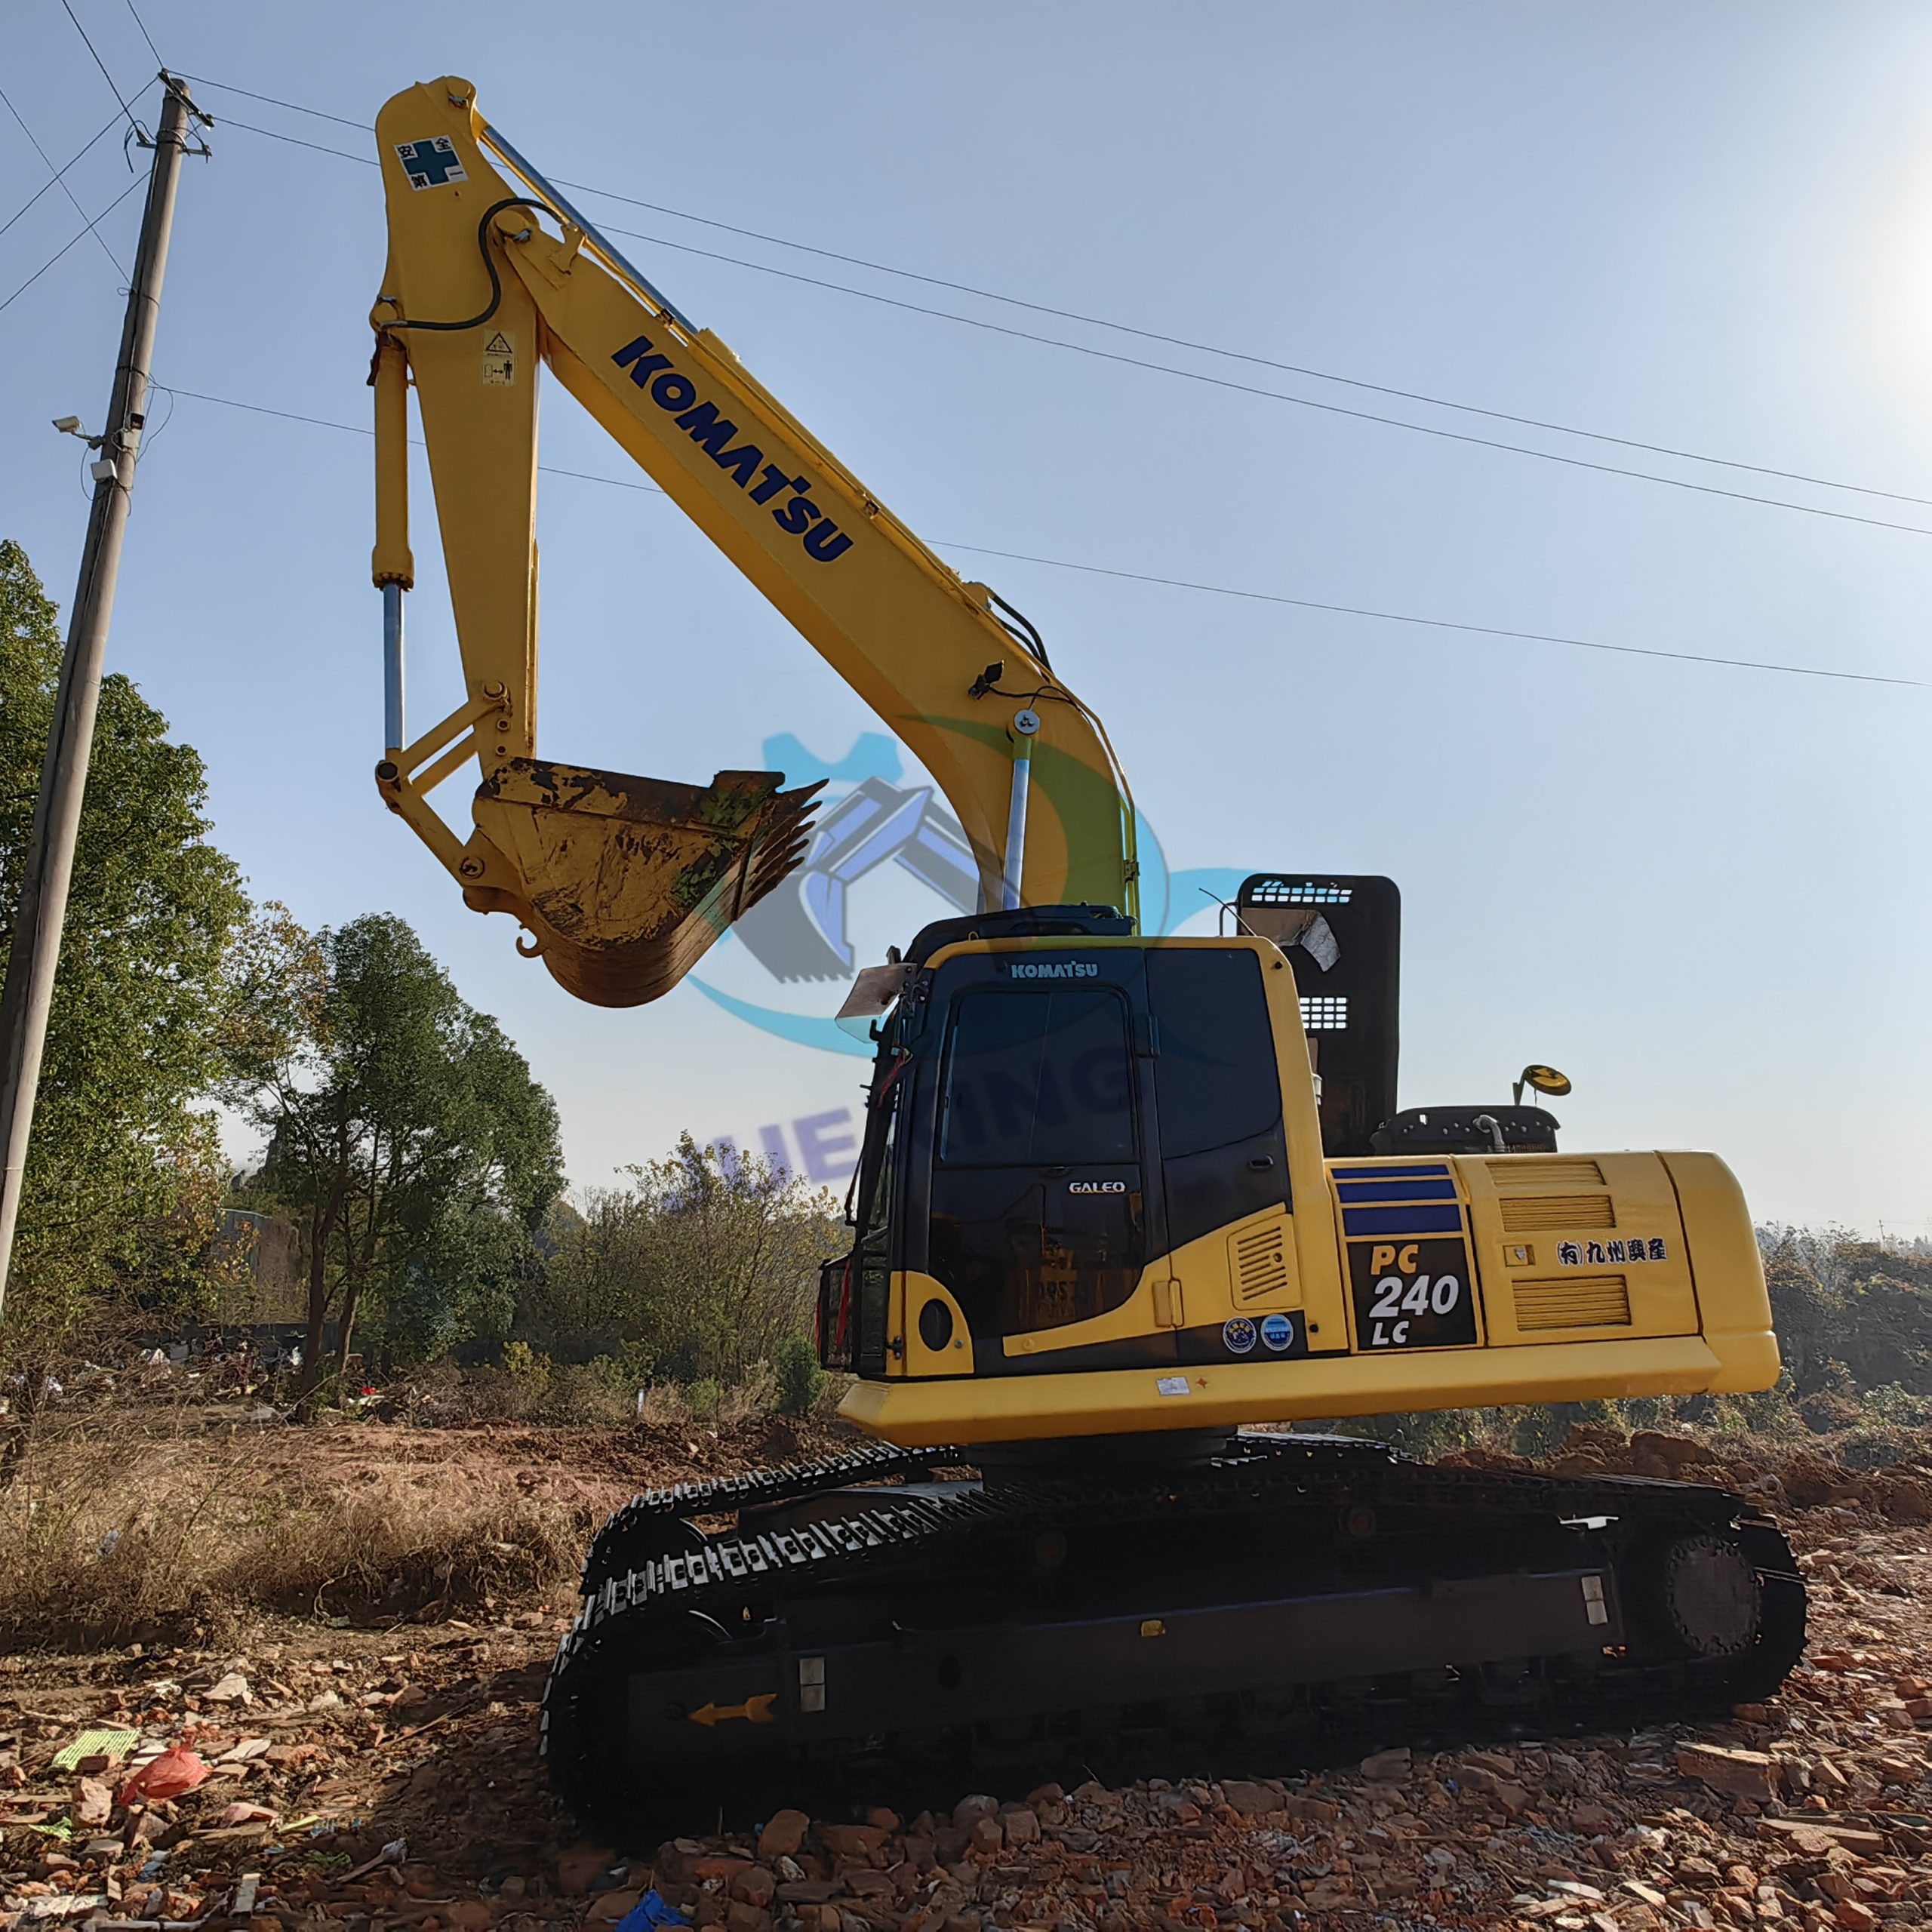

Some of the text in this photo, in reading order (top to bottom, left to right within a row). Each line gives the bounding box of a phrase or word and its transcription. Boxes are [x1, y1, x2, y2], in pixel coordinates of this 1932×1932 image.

[611, 335, 854, 563] KOMATSU
[1011, 960, 1098, 978] KOMATSU
[1069, 1181, 1125, 1193] GALEO
[1371, 1244, 1419, 1275] PC
[1369, 1275, 1459, 1318] 240
[1371, 1321, 1409, 1346] LC
